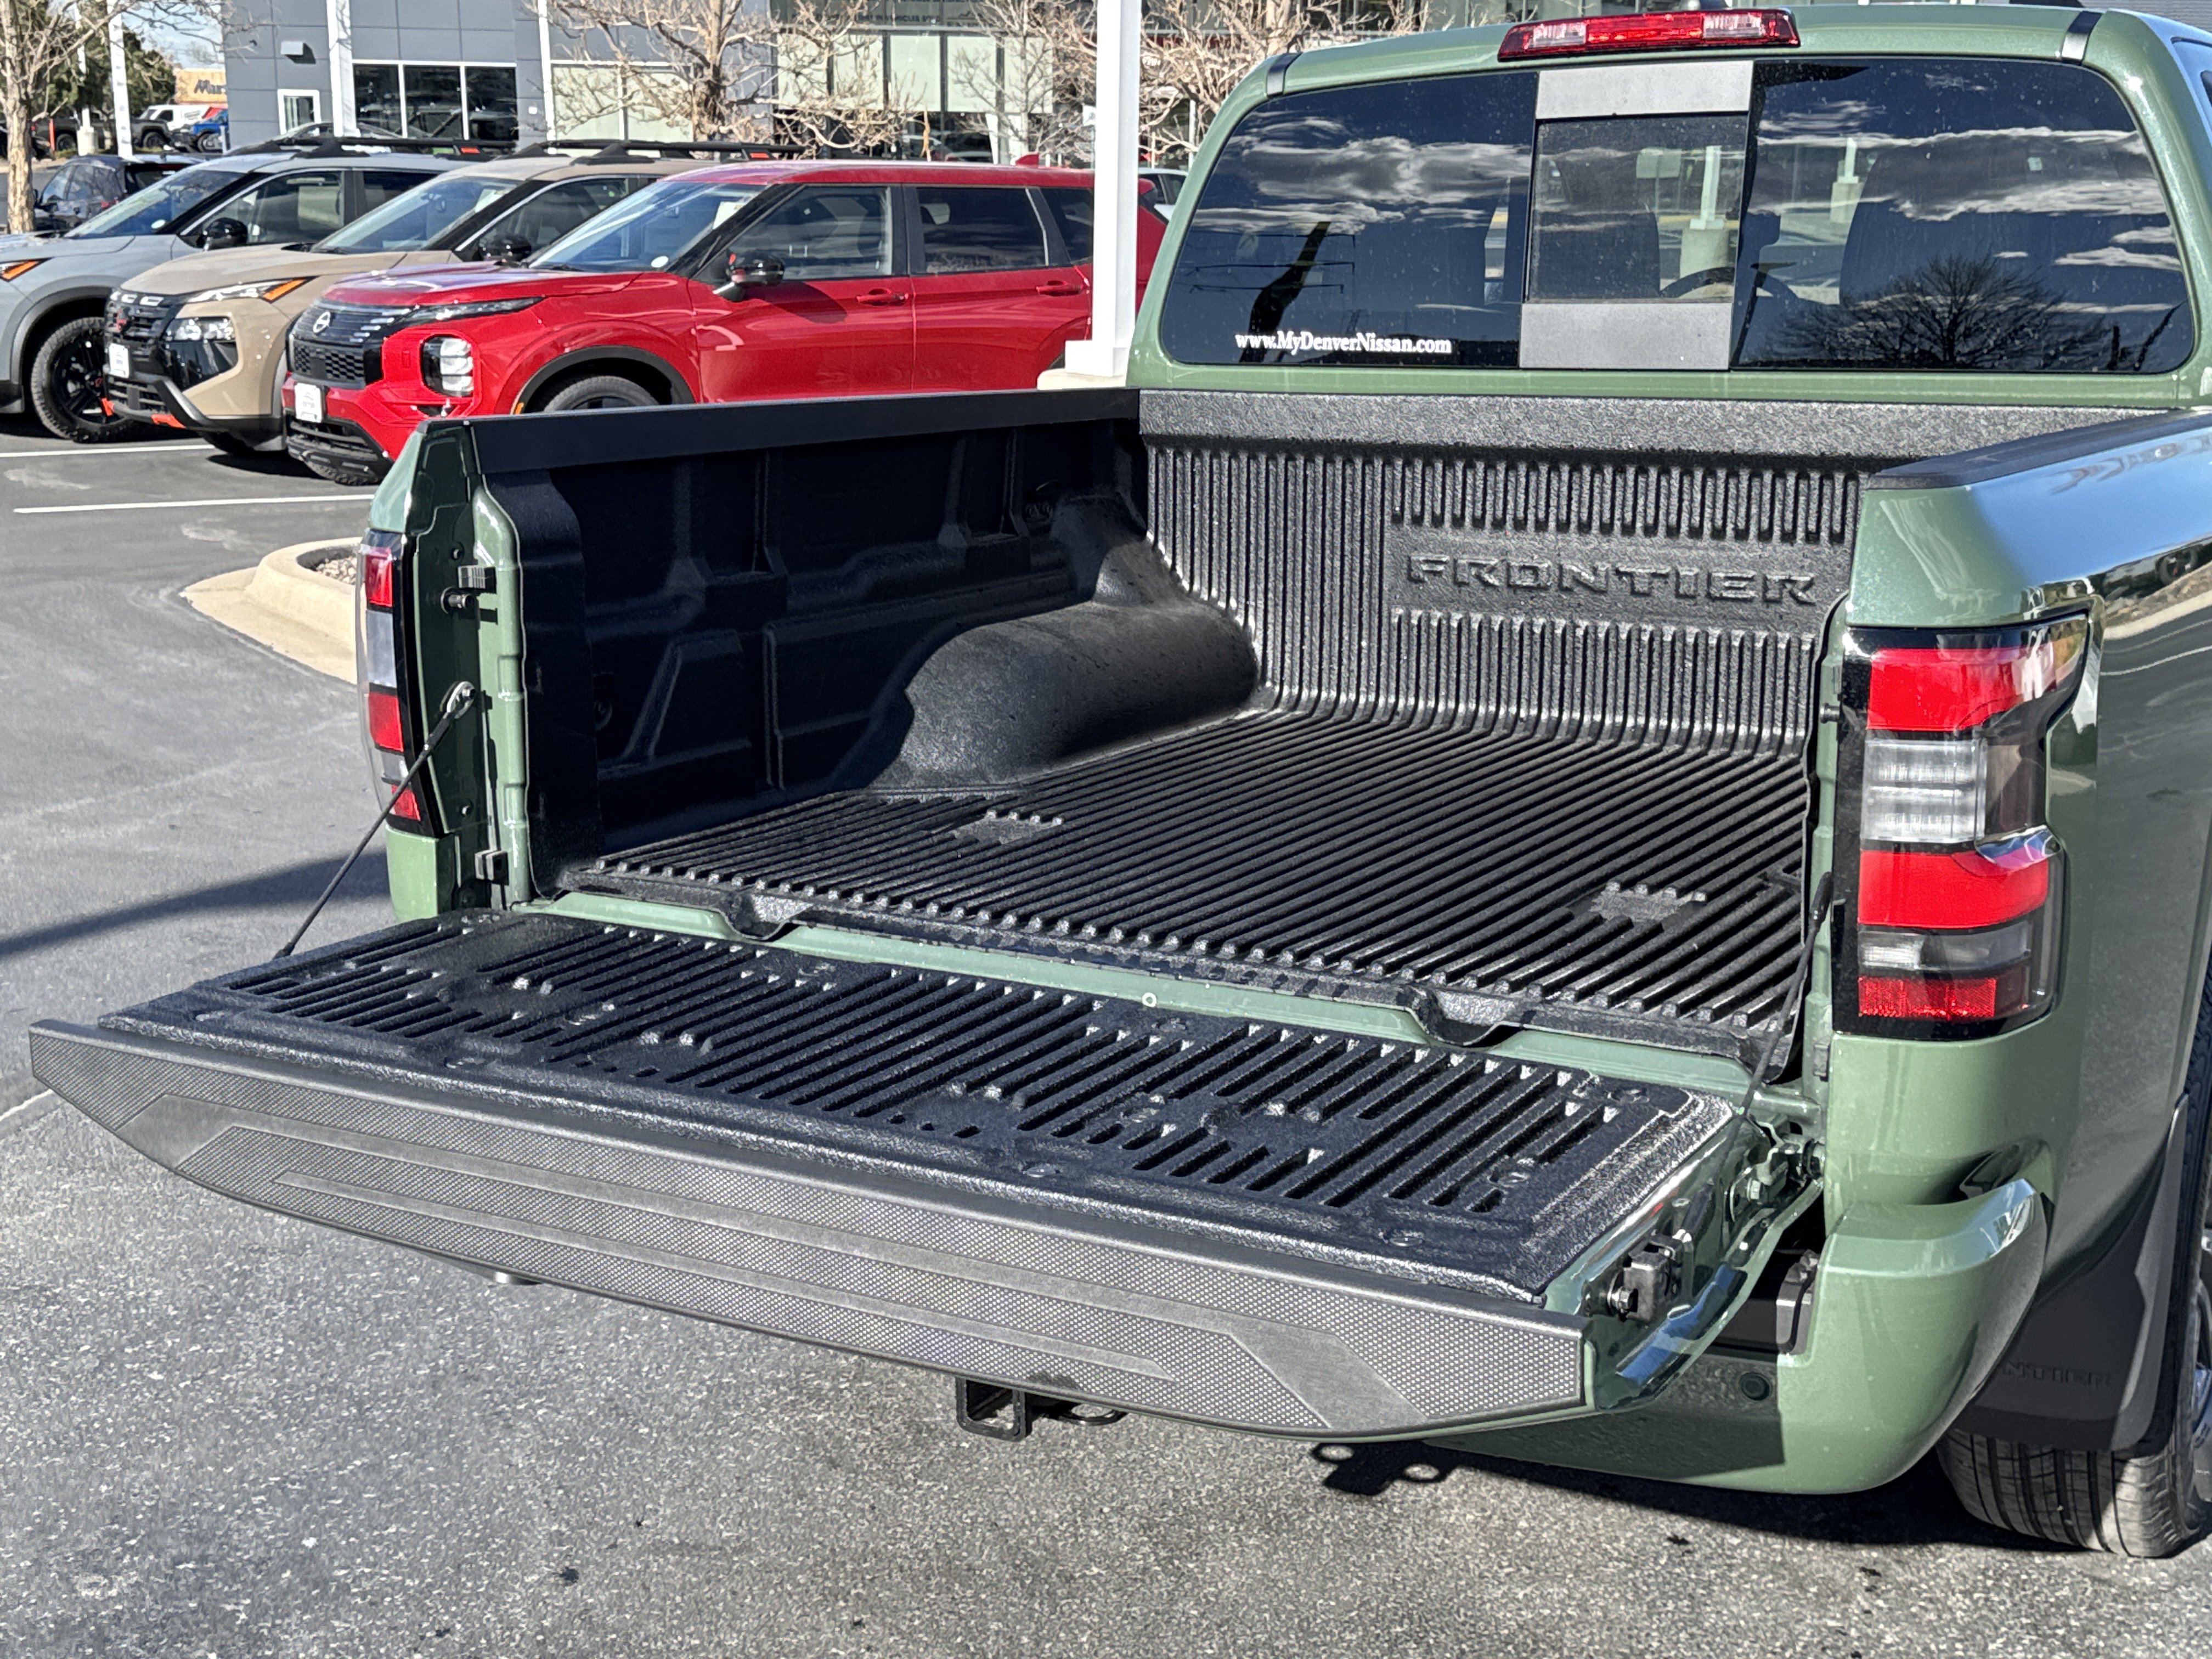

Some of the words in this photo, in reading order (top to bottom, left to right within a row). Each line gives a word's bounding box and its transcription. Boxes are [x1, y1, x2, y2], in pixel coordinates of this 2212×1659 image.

[1235, 330, 1452, 356] www.MyDenverNissan.com
[1408, 553, 1815, 605] FRONTIER
[2004, 1361, 2112, 1387] NTIER
